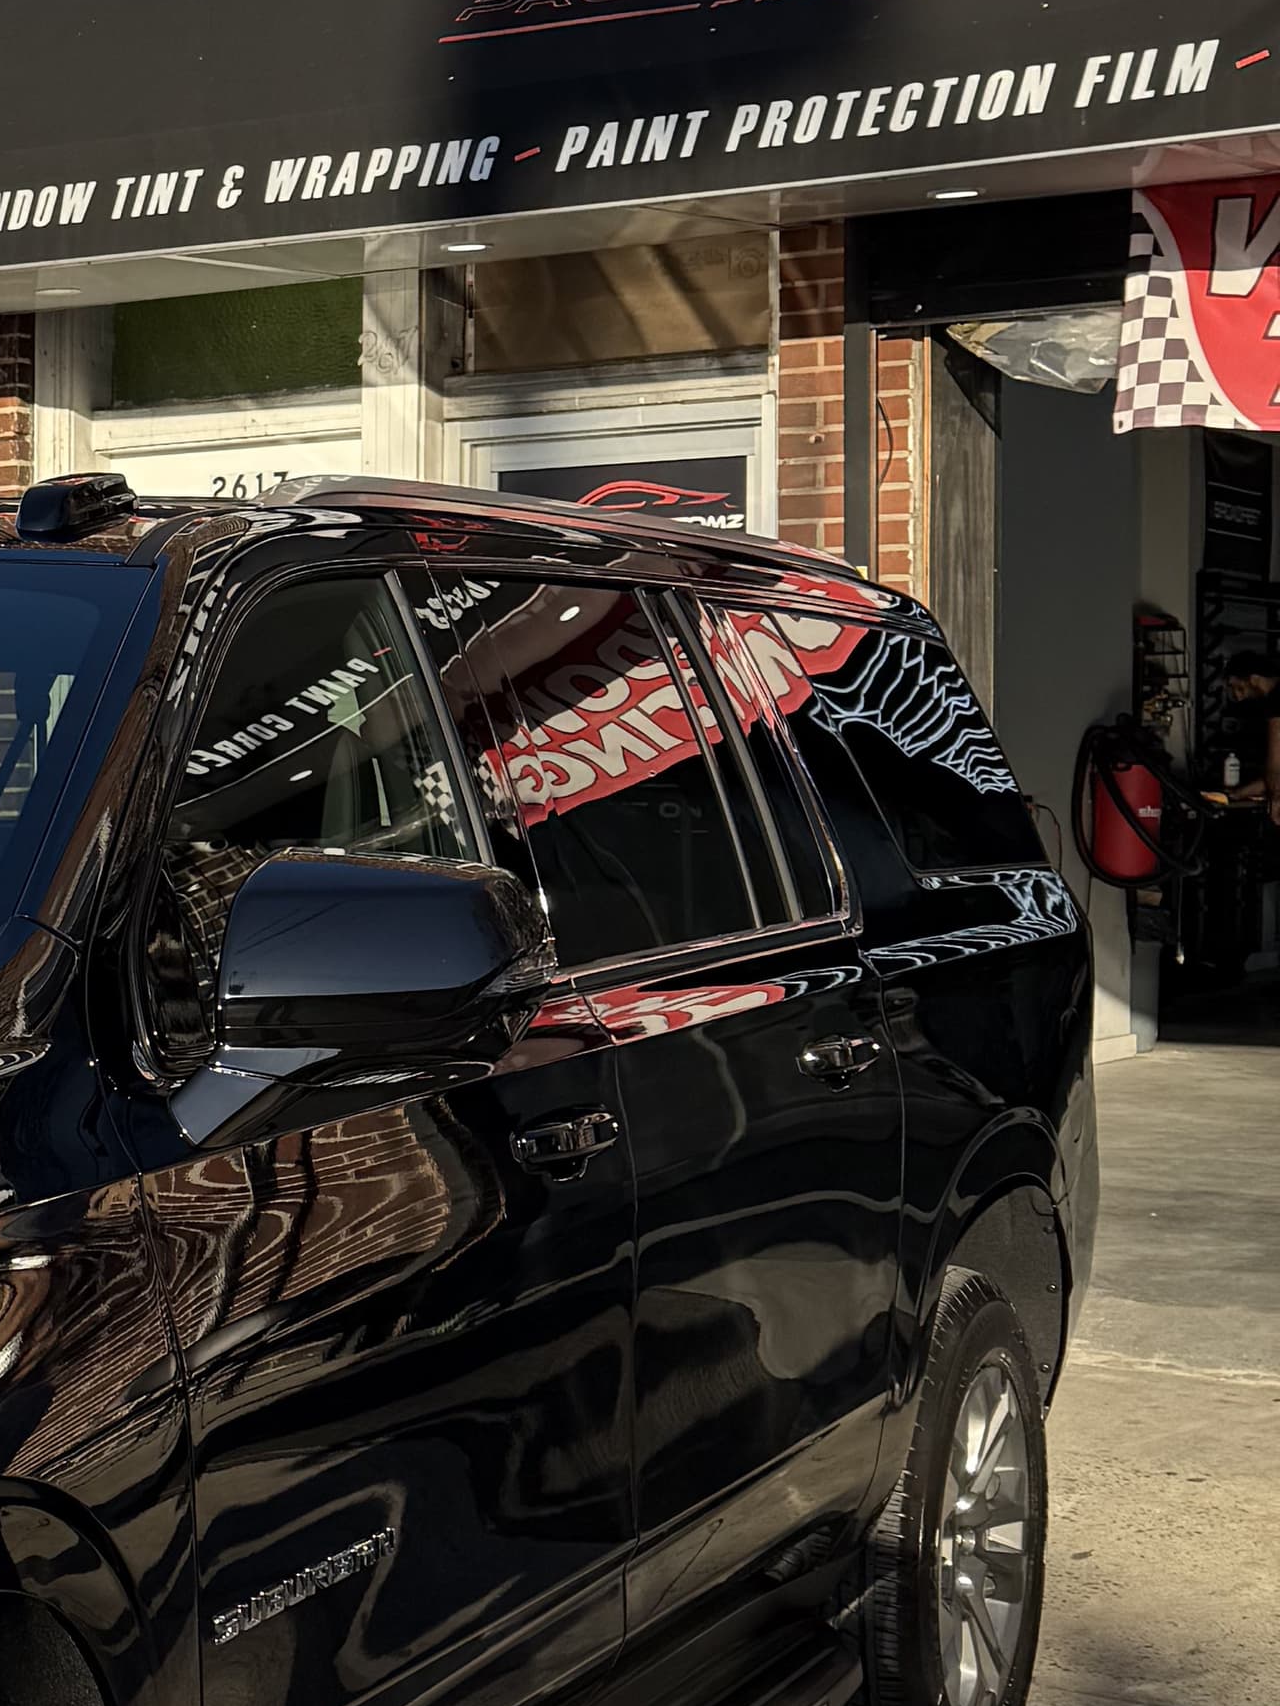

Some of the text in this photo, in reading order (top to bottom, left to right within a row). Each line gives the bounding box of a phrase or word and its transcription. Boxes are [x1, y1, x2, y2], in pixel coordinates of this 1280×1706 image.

[111, 169, 204, 221] TINT
[215, 165, 245, 210] &
[264, 135, 501, 205] WRAPPING
[554, 110, 709, 173] PAINT
[725, 62, 1056, 153] PROTECTION
[1073, 38, 1220, 109] FILM
